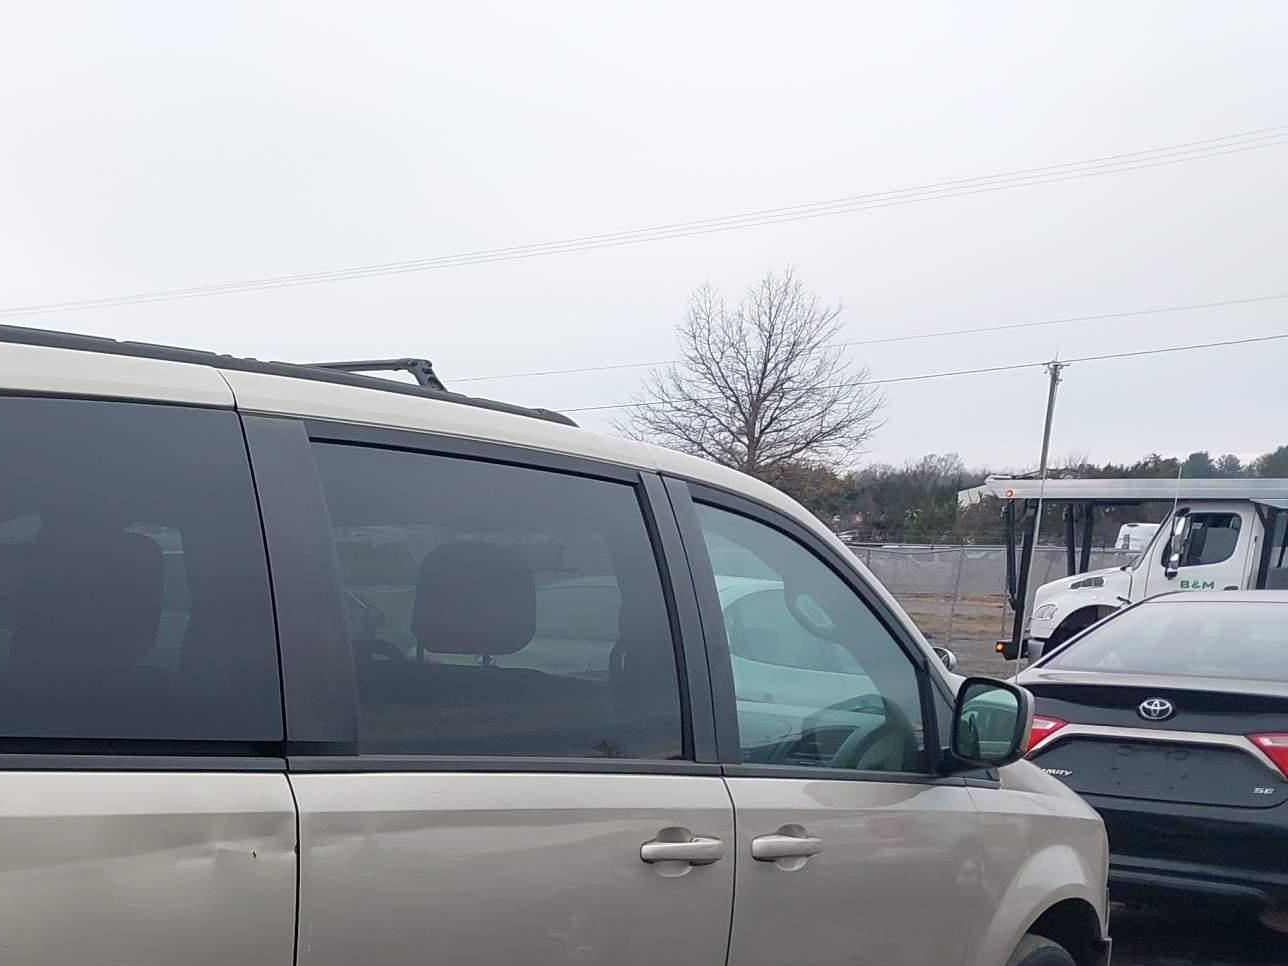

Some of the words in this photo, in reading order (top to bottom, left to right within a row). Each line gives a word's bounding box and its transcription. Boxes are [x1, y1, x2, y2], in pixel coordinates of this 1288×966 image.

[1180, 580, 1215, 590] B&M
[1041, 768, 1073, 776] MRY
[1253, 787, 1274, 795] SE
